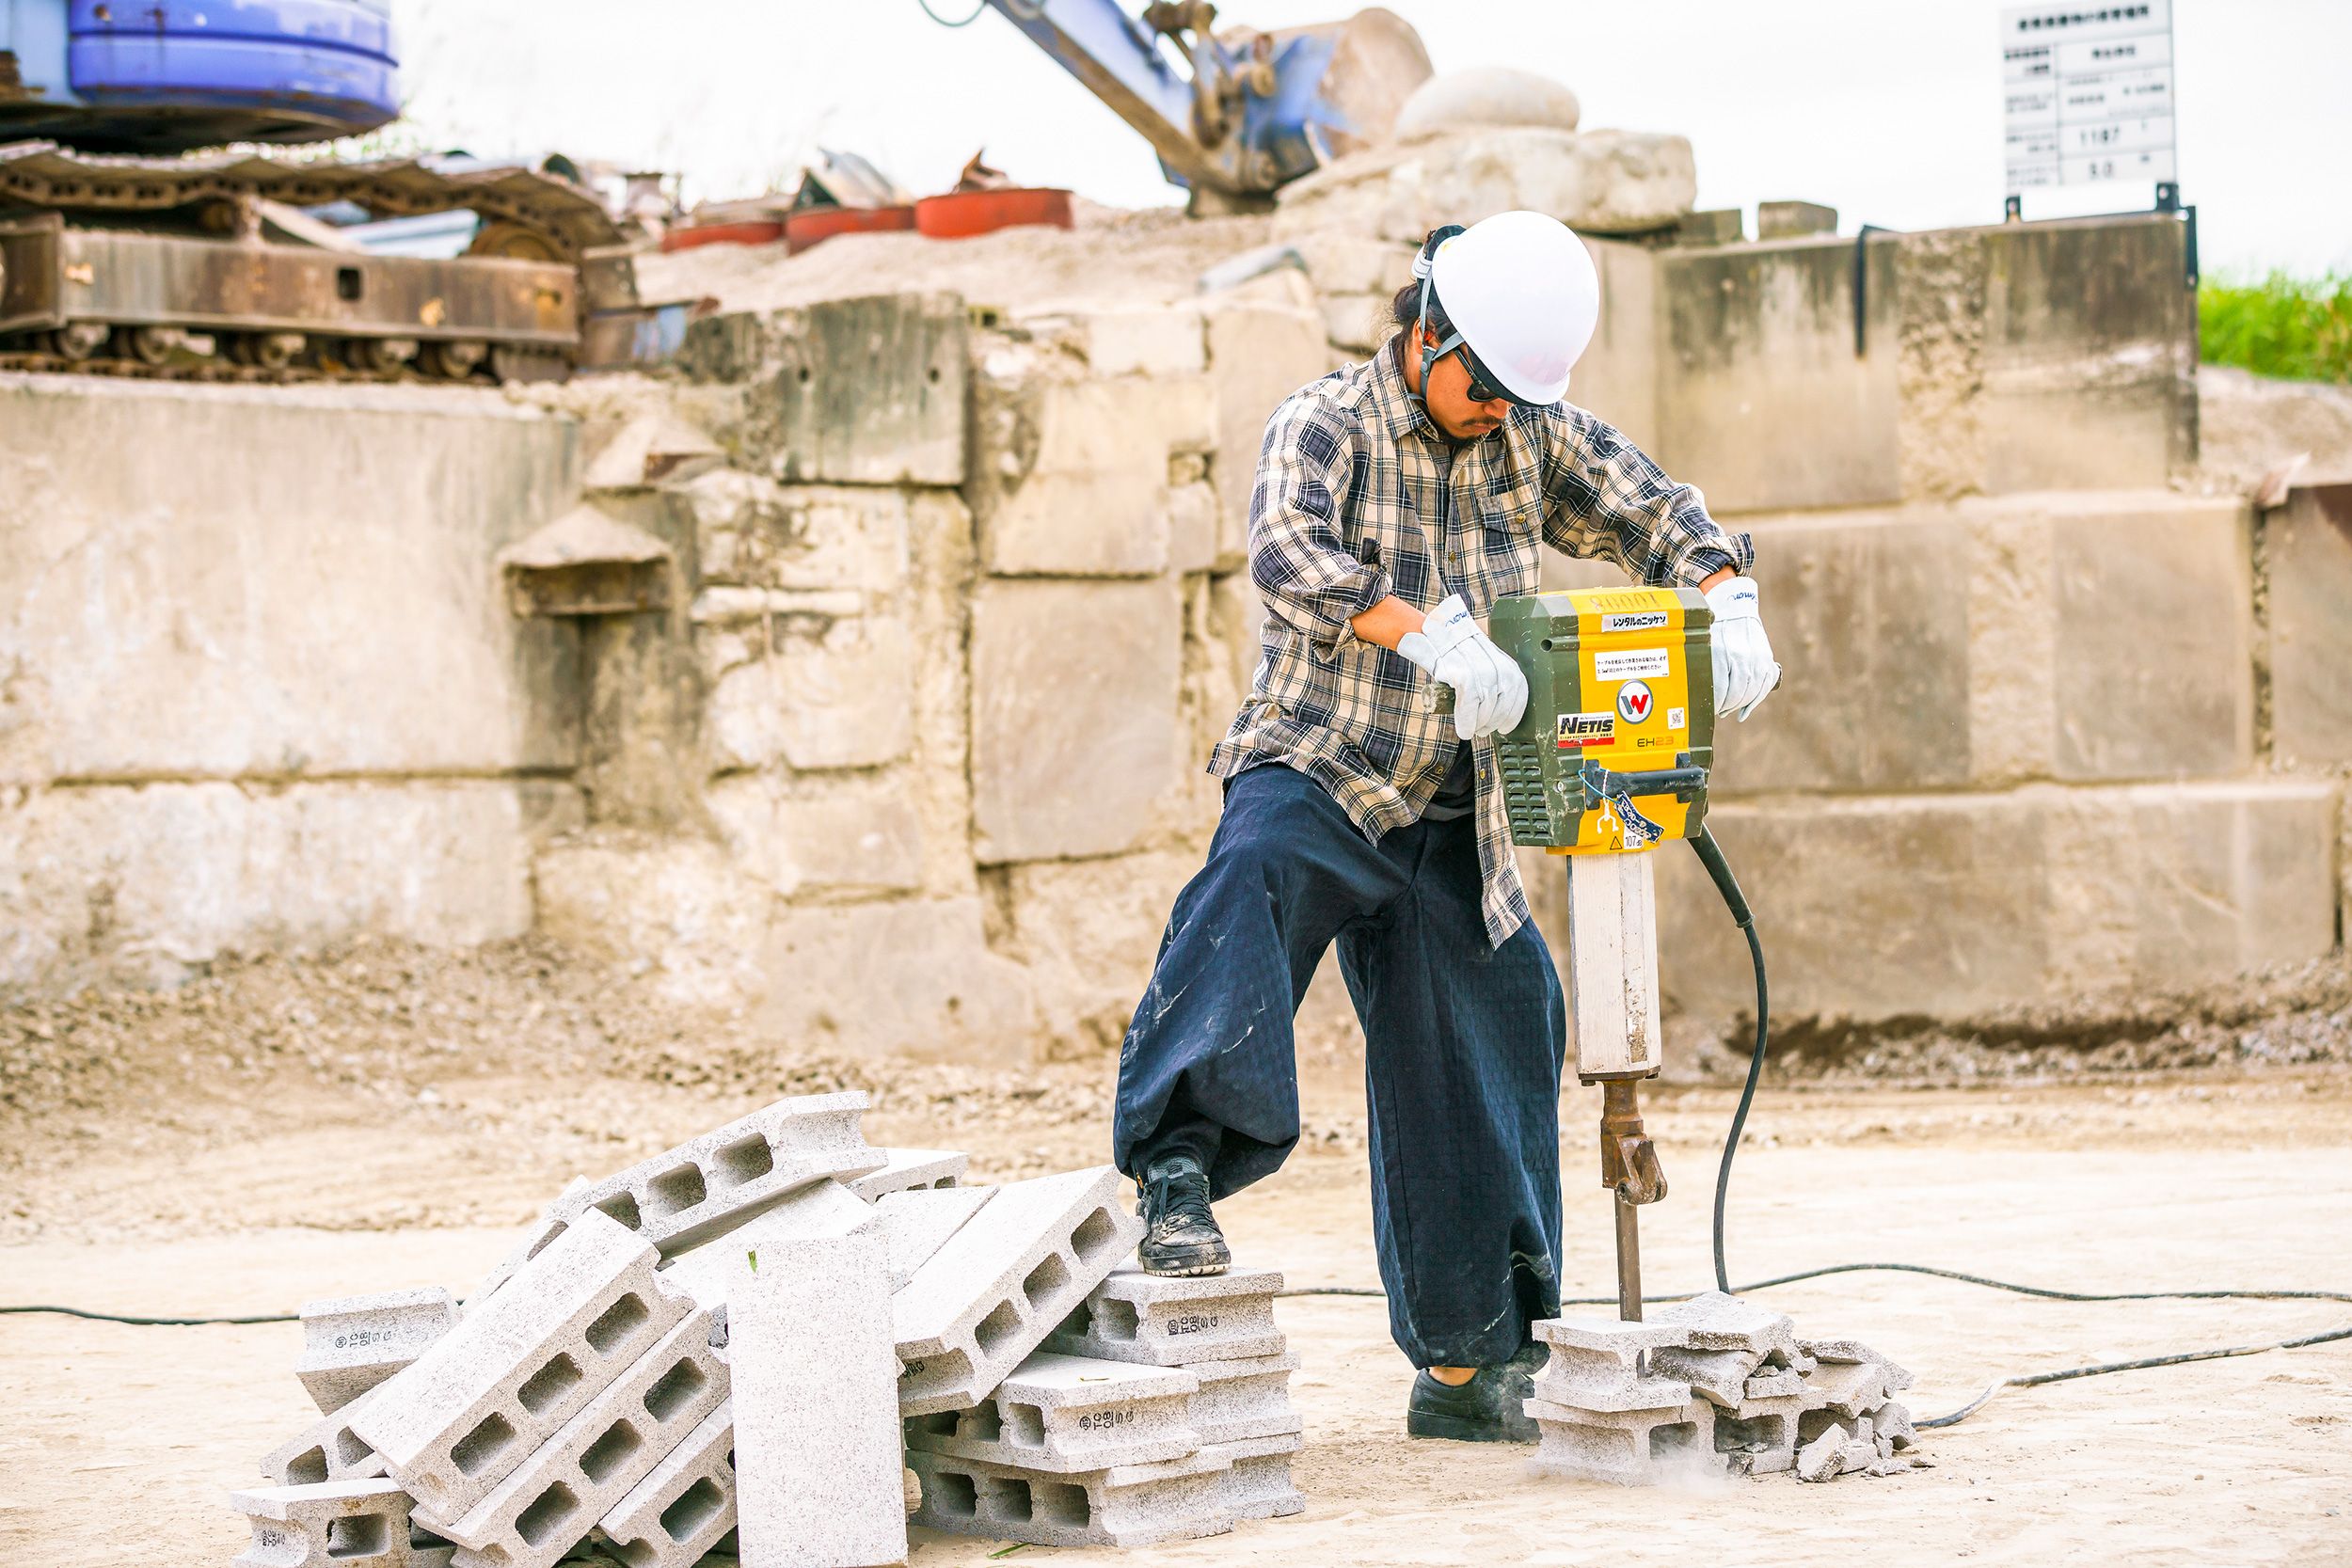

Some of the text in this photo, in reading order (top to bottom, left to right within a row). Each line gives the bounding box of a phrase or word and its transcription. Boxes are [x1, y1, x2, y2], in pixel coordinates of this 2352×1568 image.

[1613, 615, 1666, 627] レンタルのニッケン
[1559, 717, 1614, 736] NETIS
[1637, 736, 1675, 748] EH23
[1625, 836, 1637, 847] 107
